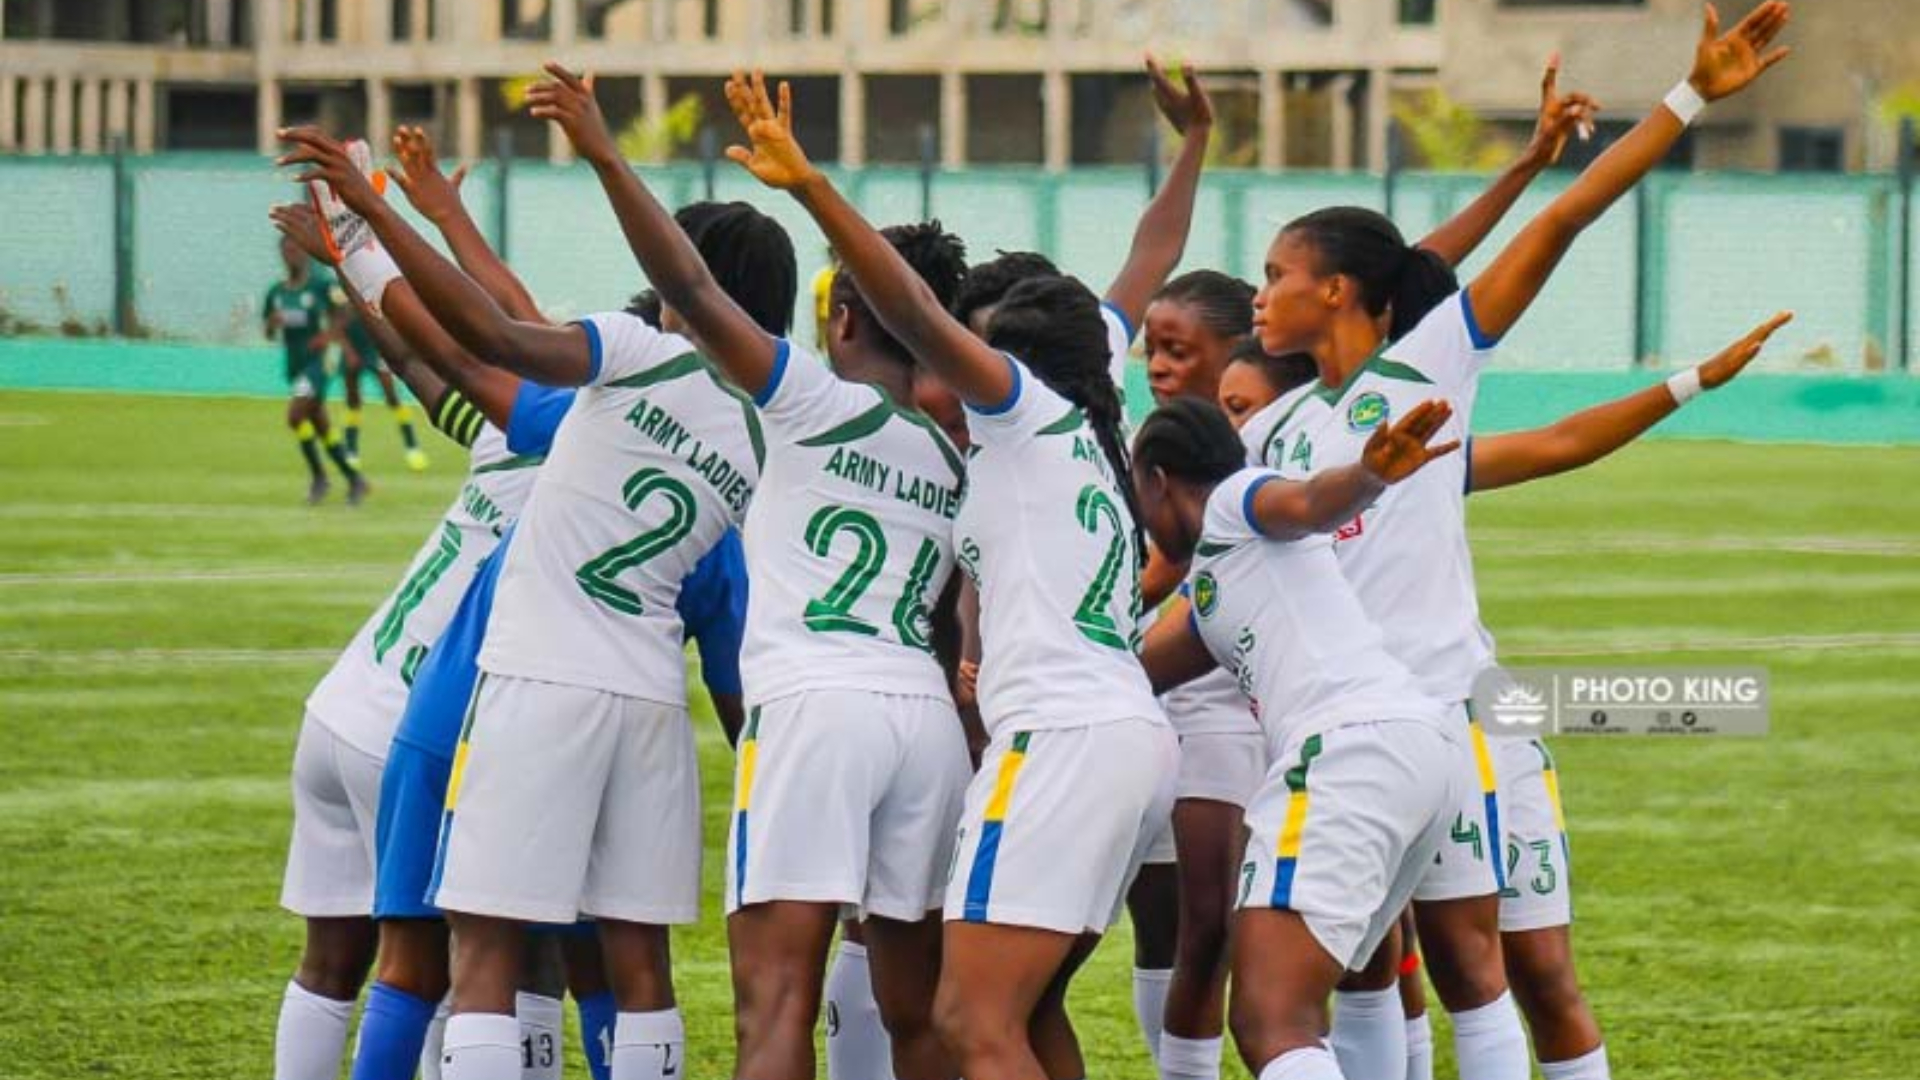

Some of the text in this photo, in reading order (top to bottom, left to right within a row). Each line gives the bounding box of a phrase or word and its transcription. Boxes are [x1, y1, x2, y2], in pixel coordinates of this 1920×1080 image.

[624, 398, 753, 512] ARMY LADIES
[823, 446, 960, 520] ARMY LADIE
[1274, 431, 1312, 471] 14
[575, 467, 697, 616] 2
[803, 505, 942, 655] 26
[521, 1034, 554, 1069] 13
